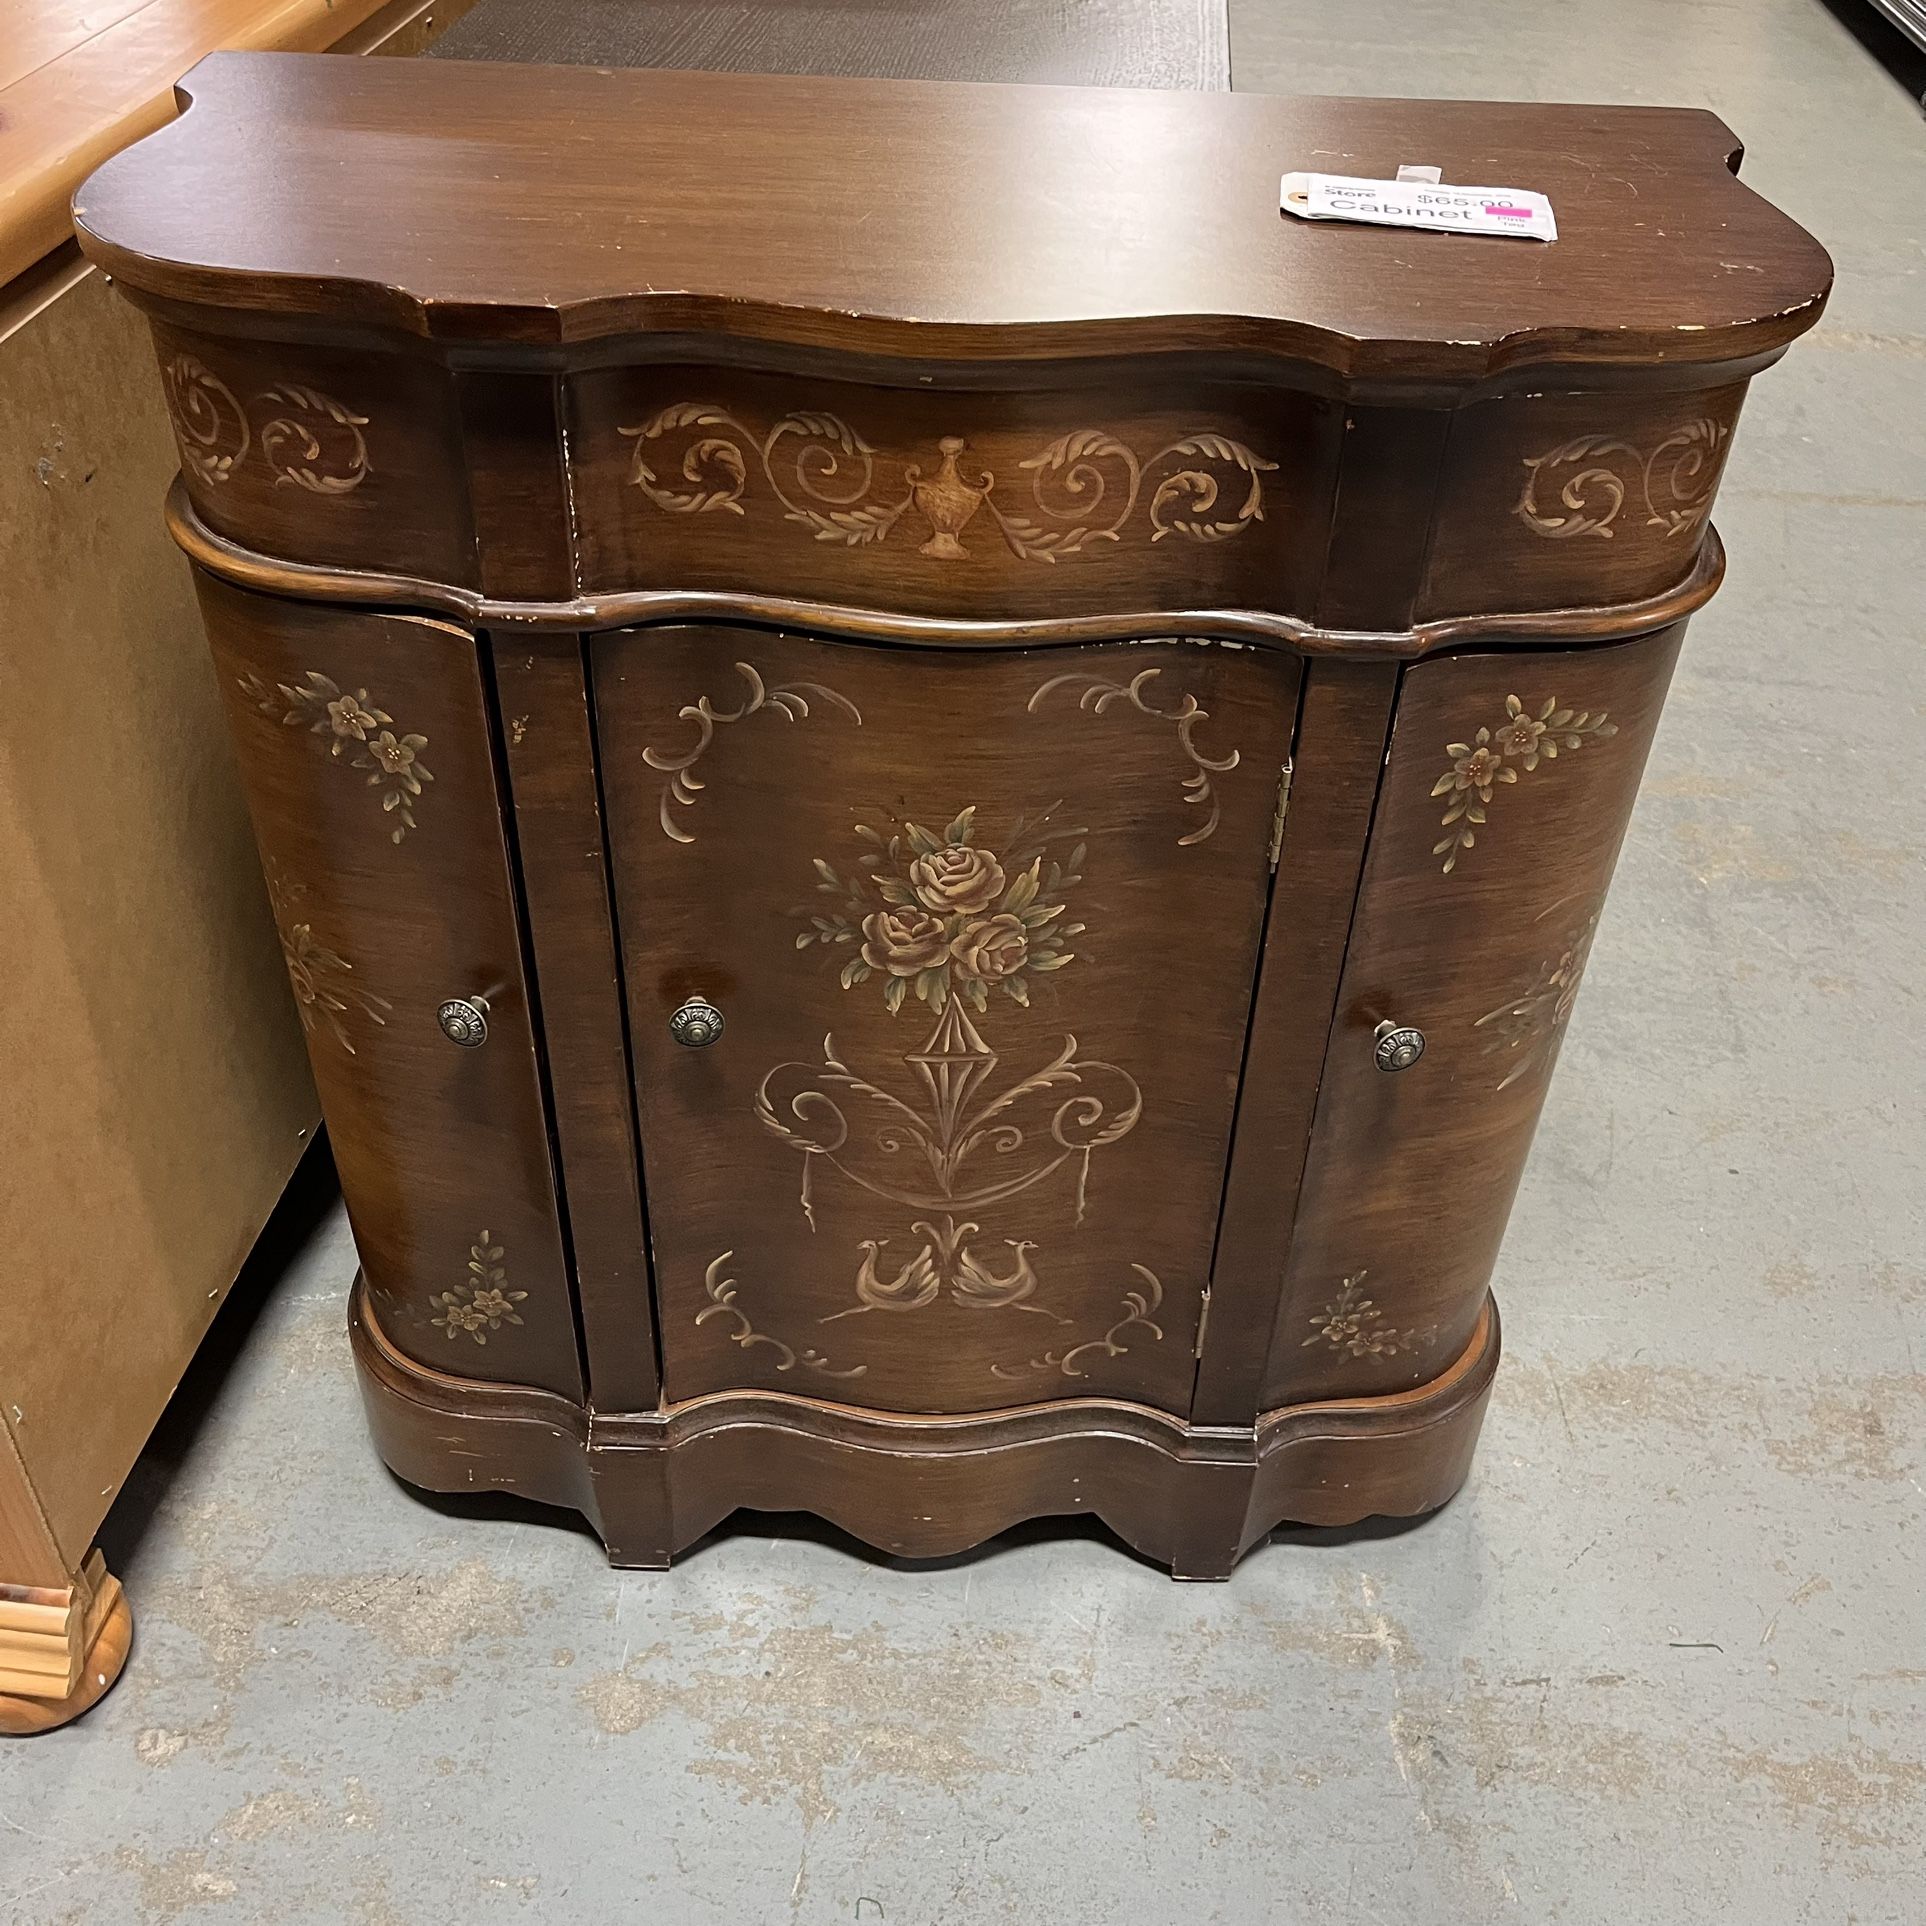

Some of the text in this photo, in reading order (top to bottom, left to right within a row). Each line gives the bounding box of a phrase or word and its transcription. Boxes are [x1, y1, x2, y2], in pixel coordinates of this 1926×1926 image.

[1324, 188, 1376, 198] Store
[1417, 195, 1513, 209] $65.00
[1330, 200, 1473, 220] Cabinet
